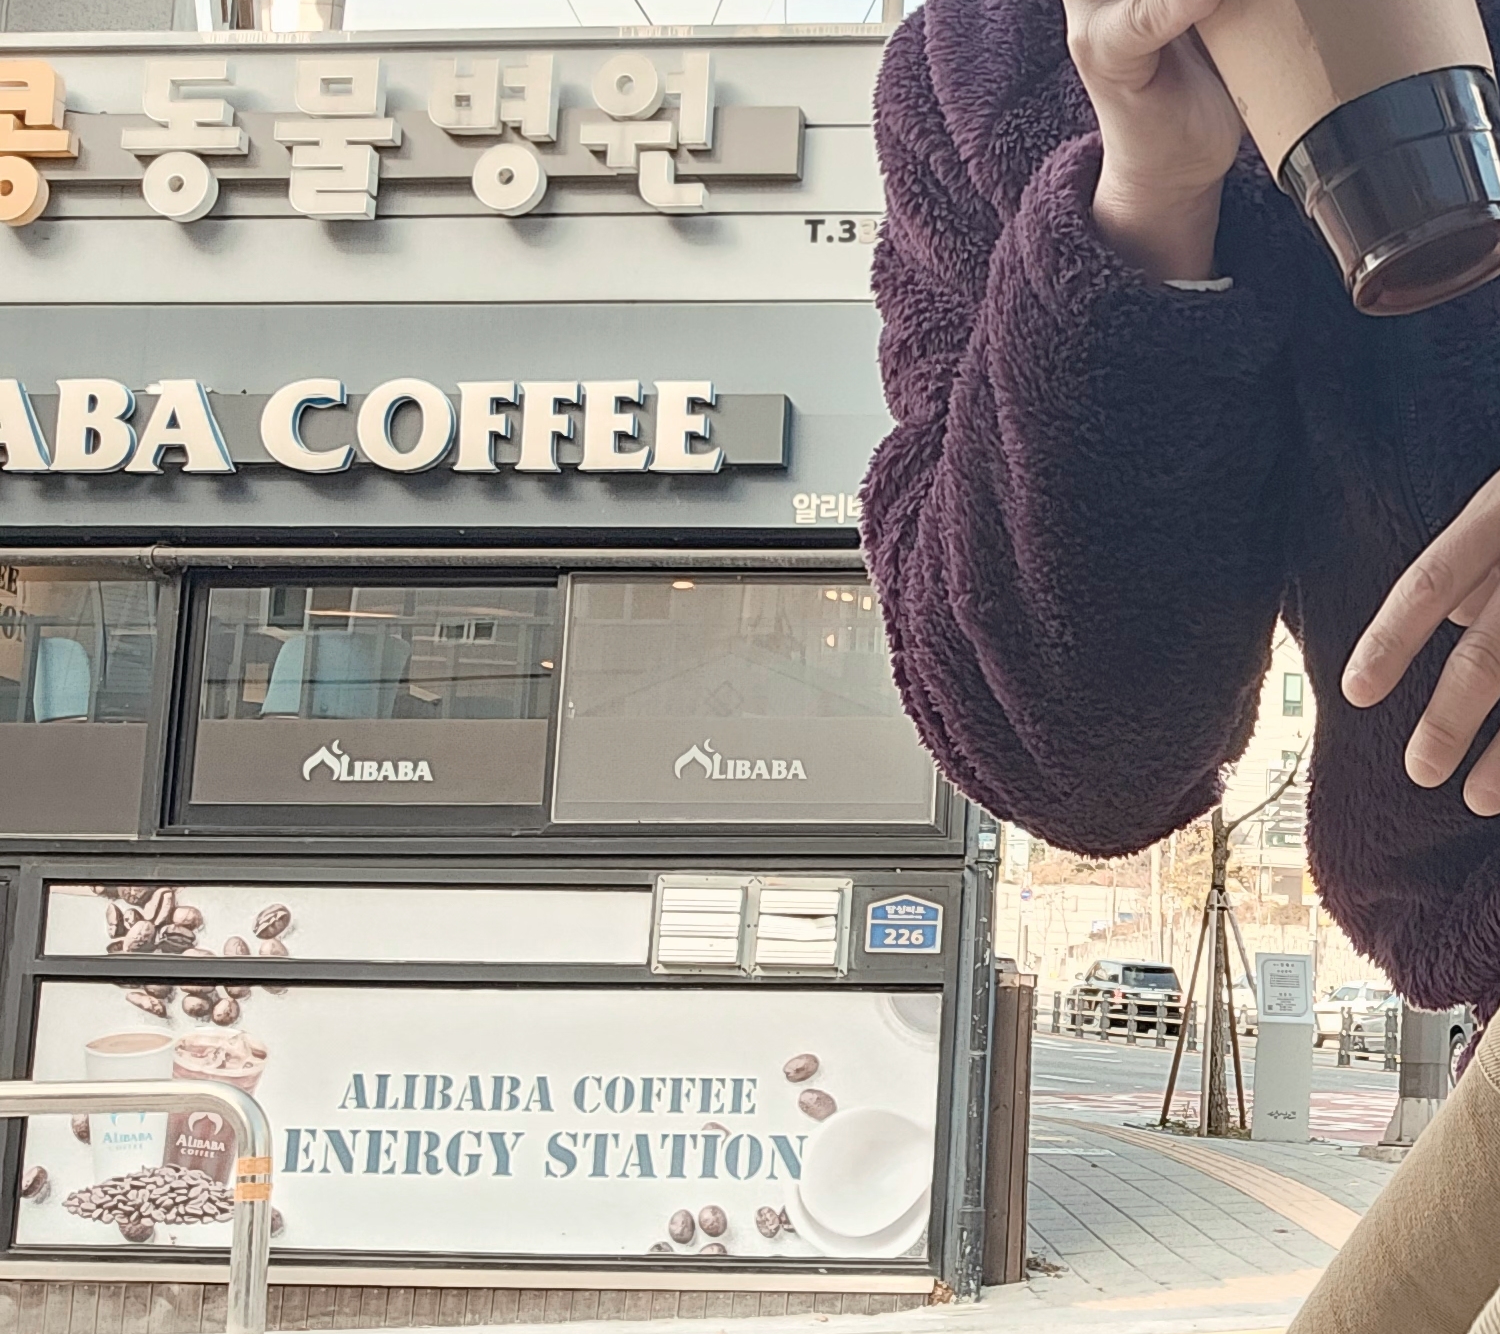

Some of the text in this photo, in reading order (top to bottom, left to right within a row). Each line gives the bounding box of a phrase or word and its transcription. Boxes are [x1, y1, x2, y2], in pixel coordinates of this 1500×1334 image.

[260, 379, 724, 474] COFFEE
[883, 928, 924, 945] 226
[338, 1073, 758, 1114] ALIBABA COFFEE
[103, 1132, 153, 1144] ALIBABA
[176, 1133, 226, 1152] ALIBABA
[180, 1148, 216, 1158] COFFEE
[283, 1128, 809, 1180] ENERGY STATION
